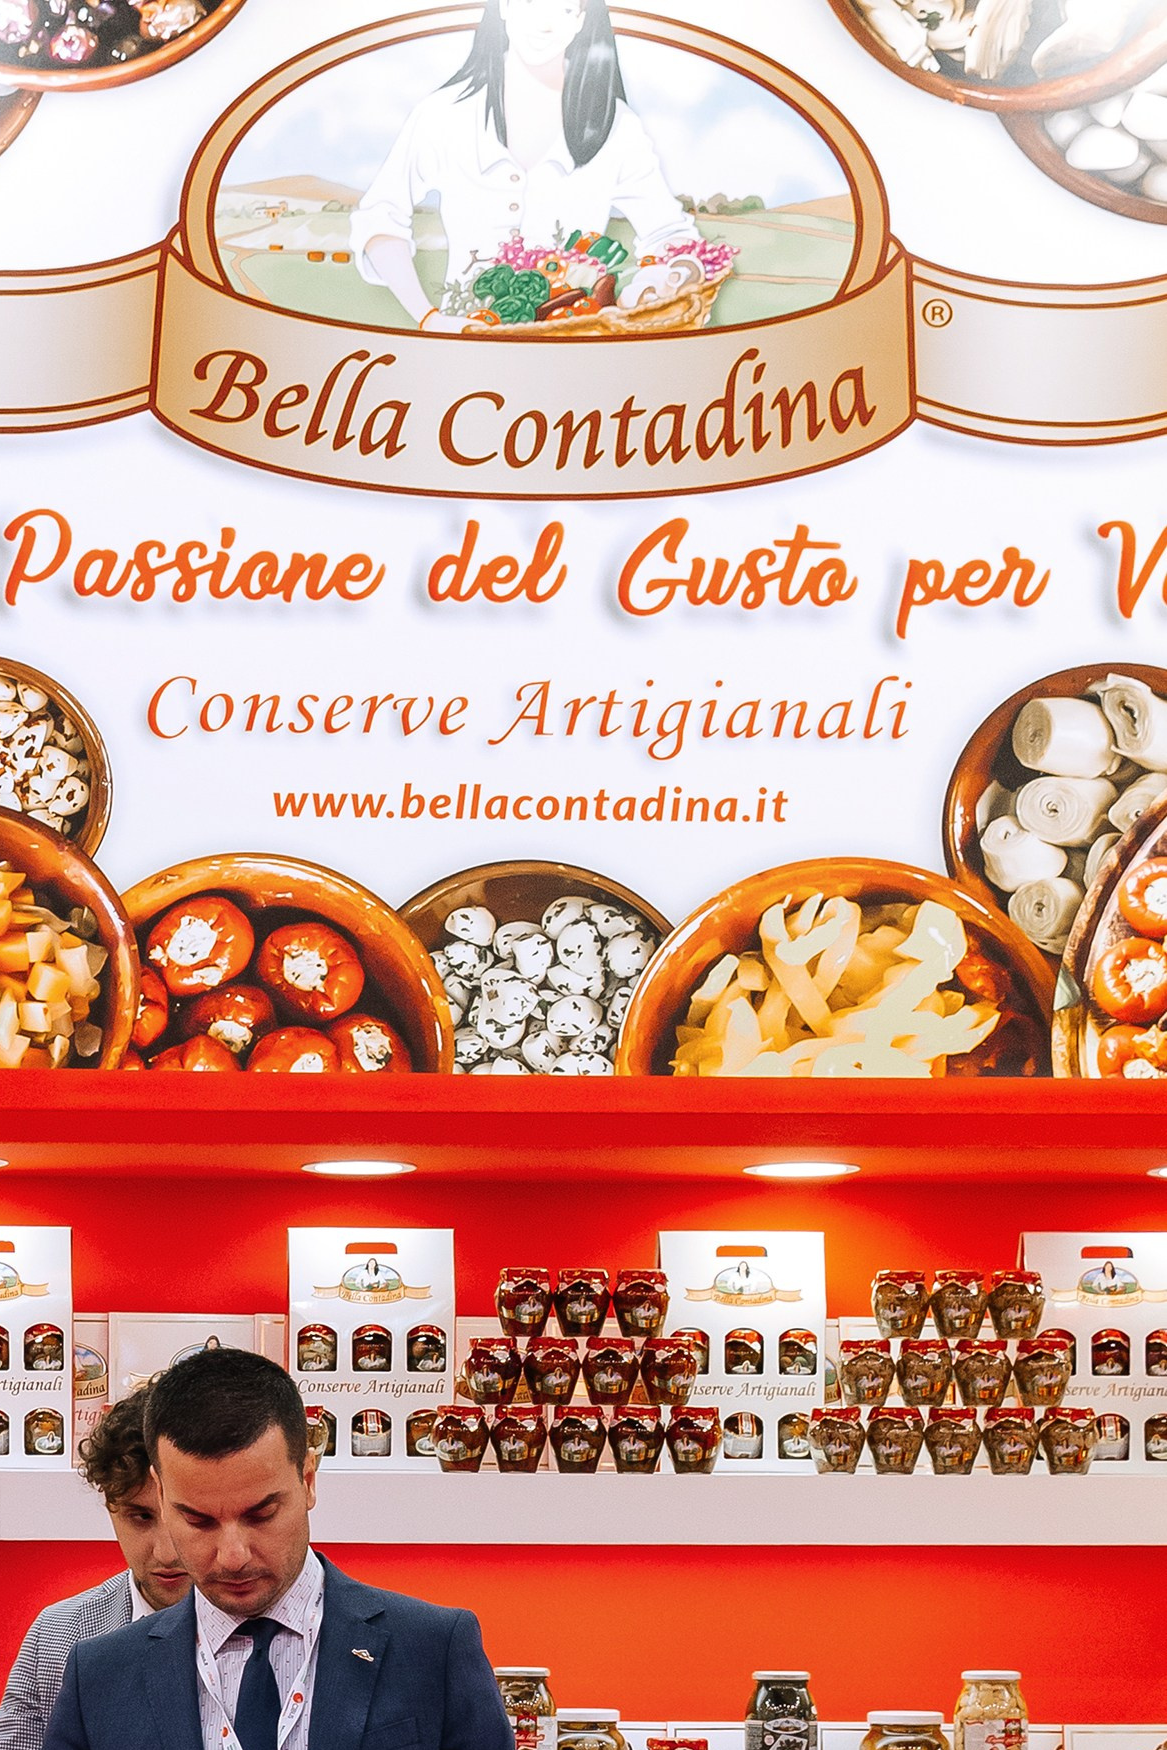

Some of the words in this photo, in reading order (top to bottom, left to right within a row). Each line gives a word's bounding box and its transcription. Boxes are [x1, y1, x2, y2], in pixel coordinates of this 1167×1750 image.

[189, 348, 412, 459] Bella
[438, 348, 878, 472] Contadina
[4, 508, 386, 607] Passione
[427, 519, 568, 604] del
[617, 517, 859, 616] Gusto
[895, 545, 1052, 640] per
[1097, 520, 1167, 620] V
[146, 675, 469, 740] Conserve
[487, 674, 915, 761] Artigianali
[272, 783, 789, 824] www.bellacontadina.it
[76, 1382, 106, 1397] adina
[297, 1379, 361, 1394] Conserve
[363, 1378, 446, 1398] Artigianali
[735, 1381, 817, 1401] Artigianali
[1065, 1387, 1100, 1398] serve
[1102, 1383, 1167, 1402] Artigian
